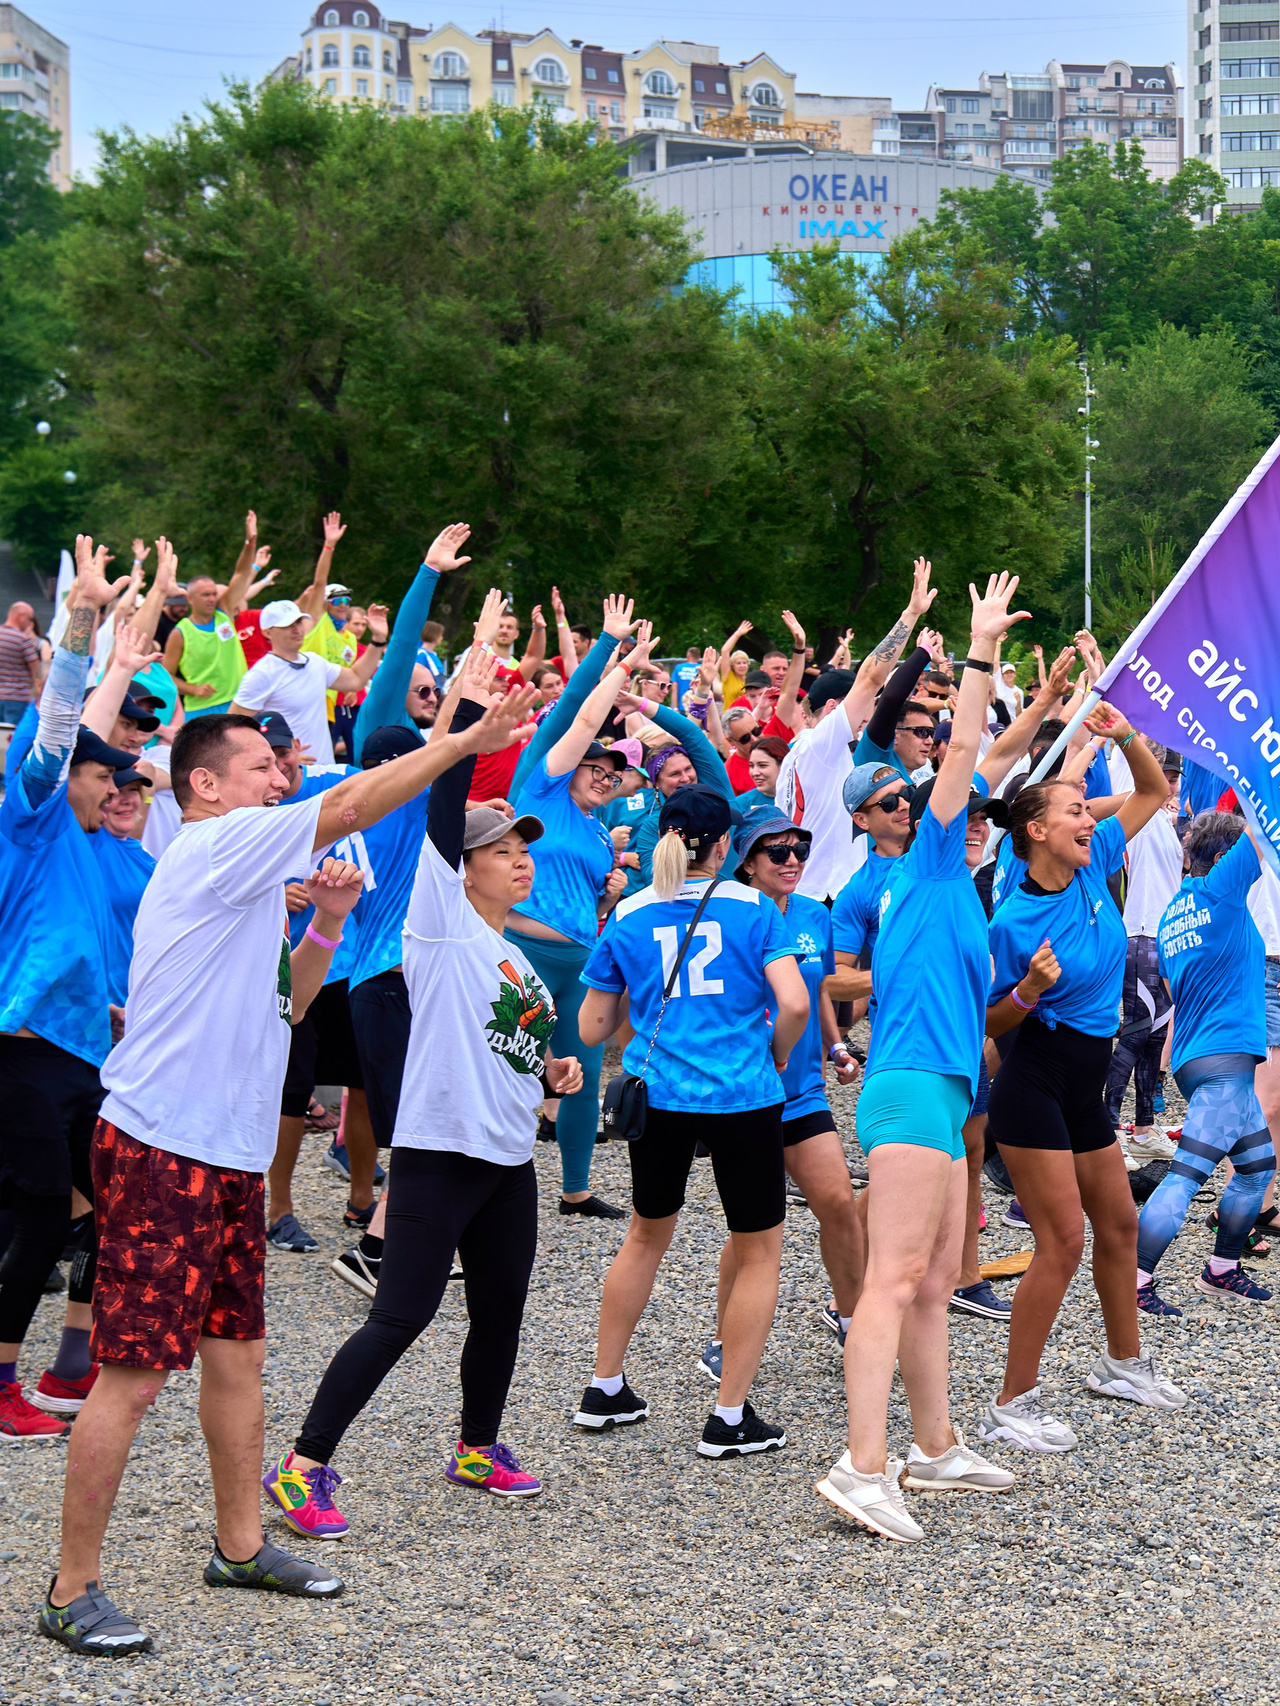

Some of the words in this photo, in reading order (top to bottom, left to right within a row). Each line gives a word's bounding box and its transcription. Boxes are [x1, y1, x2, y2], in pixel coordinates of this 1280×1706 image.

[789, 174, 887, 202] ОКЕАН
[762, 204, 919, 217] КИНОЦЕНТР
[799, 220, 886, 239] IMAX
[653, 920, 724, 998] 12
[1164, 931, 1203, 959] СОГРЕТЬ
